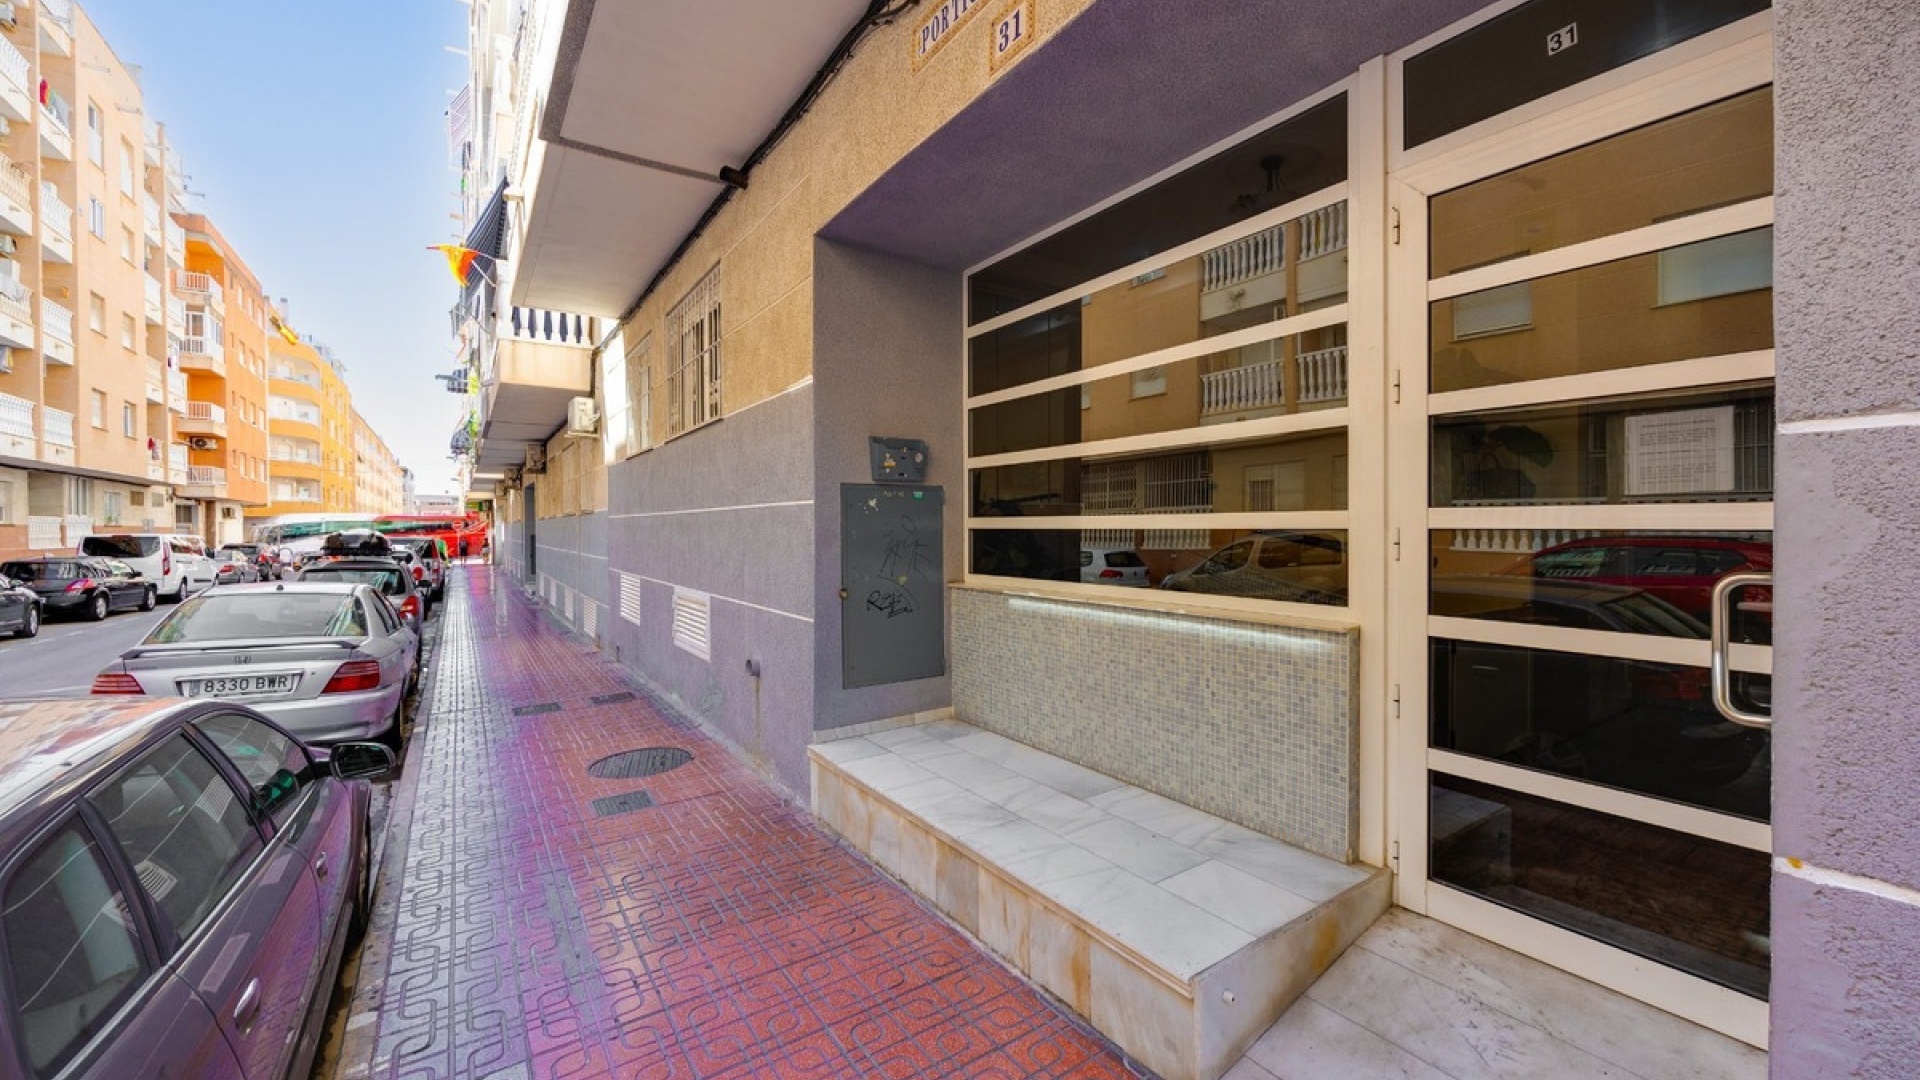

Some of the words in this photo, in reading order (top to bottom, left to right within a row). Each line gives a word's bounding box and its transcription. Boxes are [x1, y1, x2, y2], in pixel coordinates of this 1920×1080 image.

[999, 9, 1021, 52] 31
[1550, 26, 1574, 52] 31
[204, 678, 249, 693] 8330
[255, 675, 288, 690] BWR
